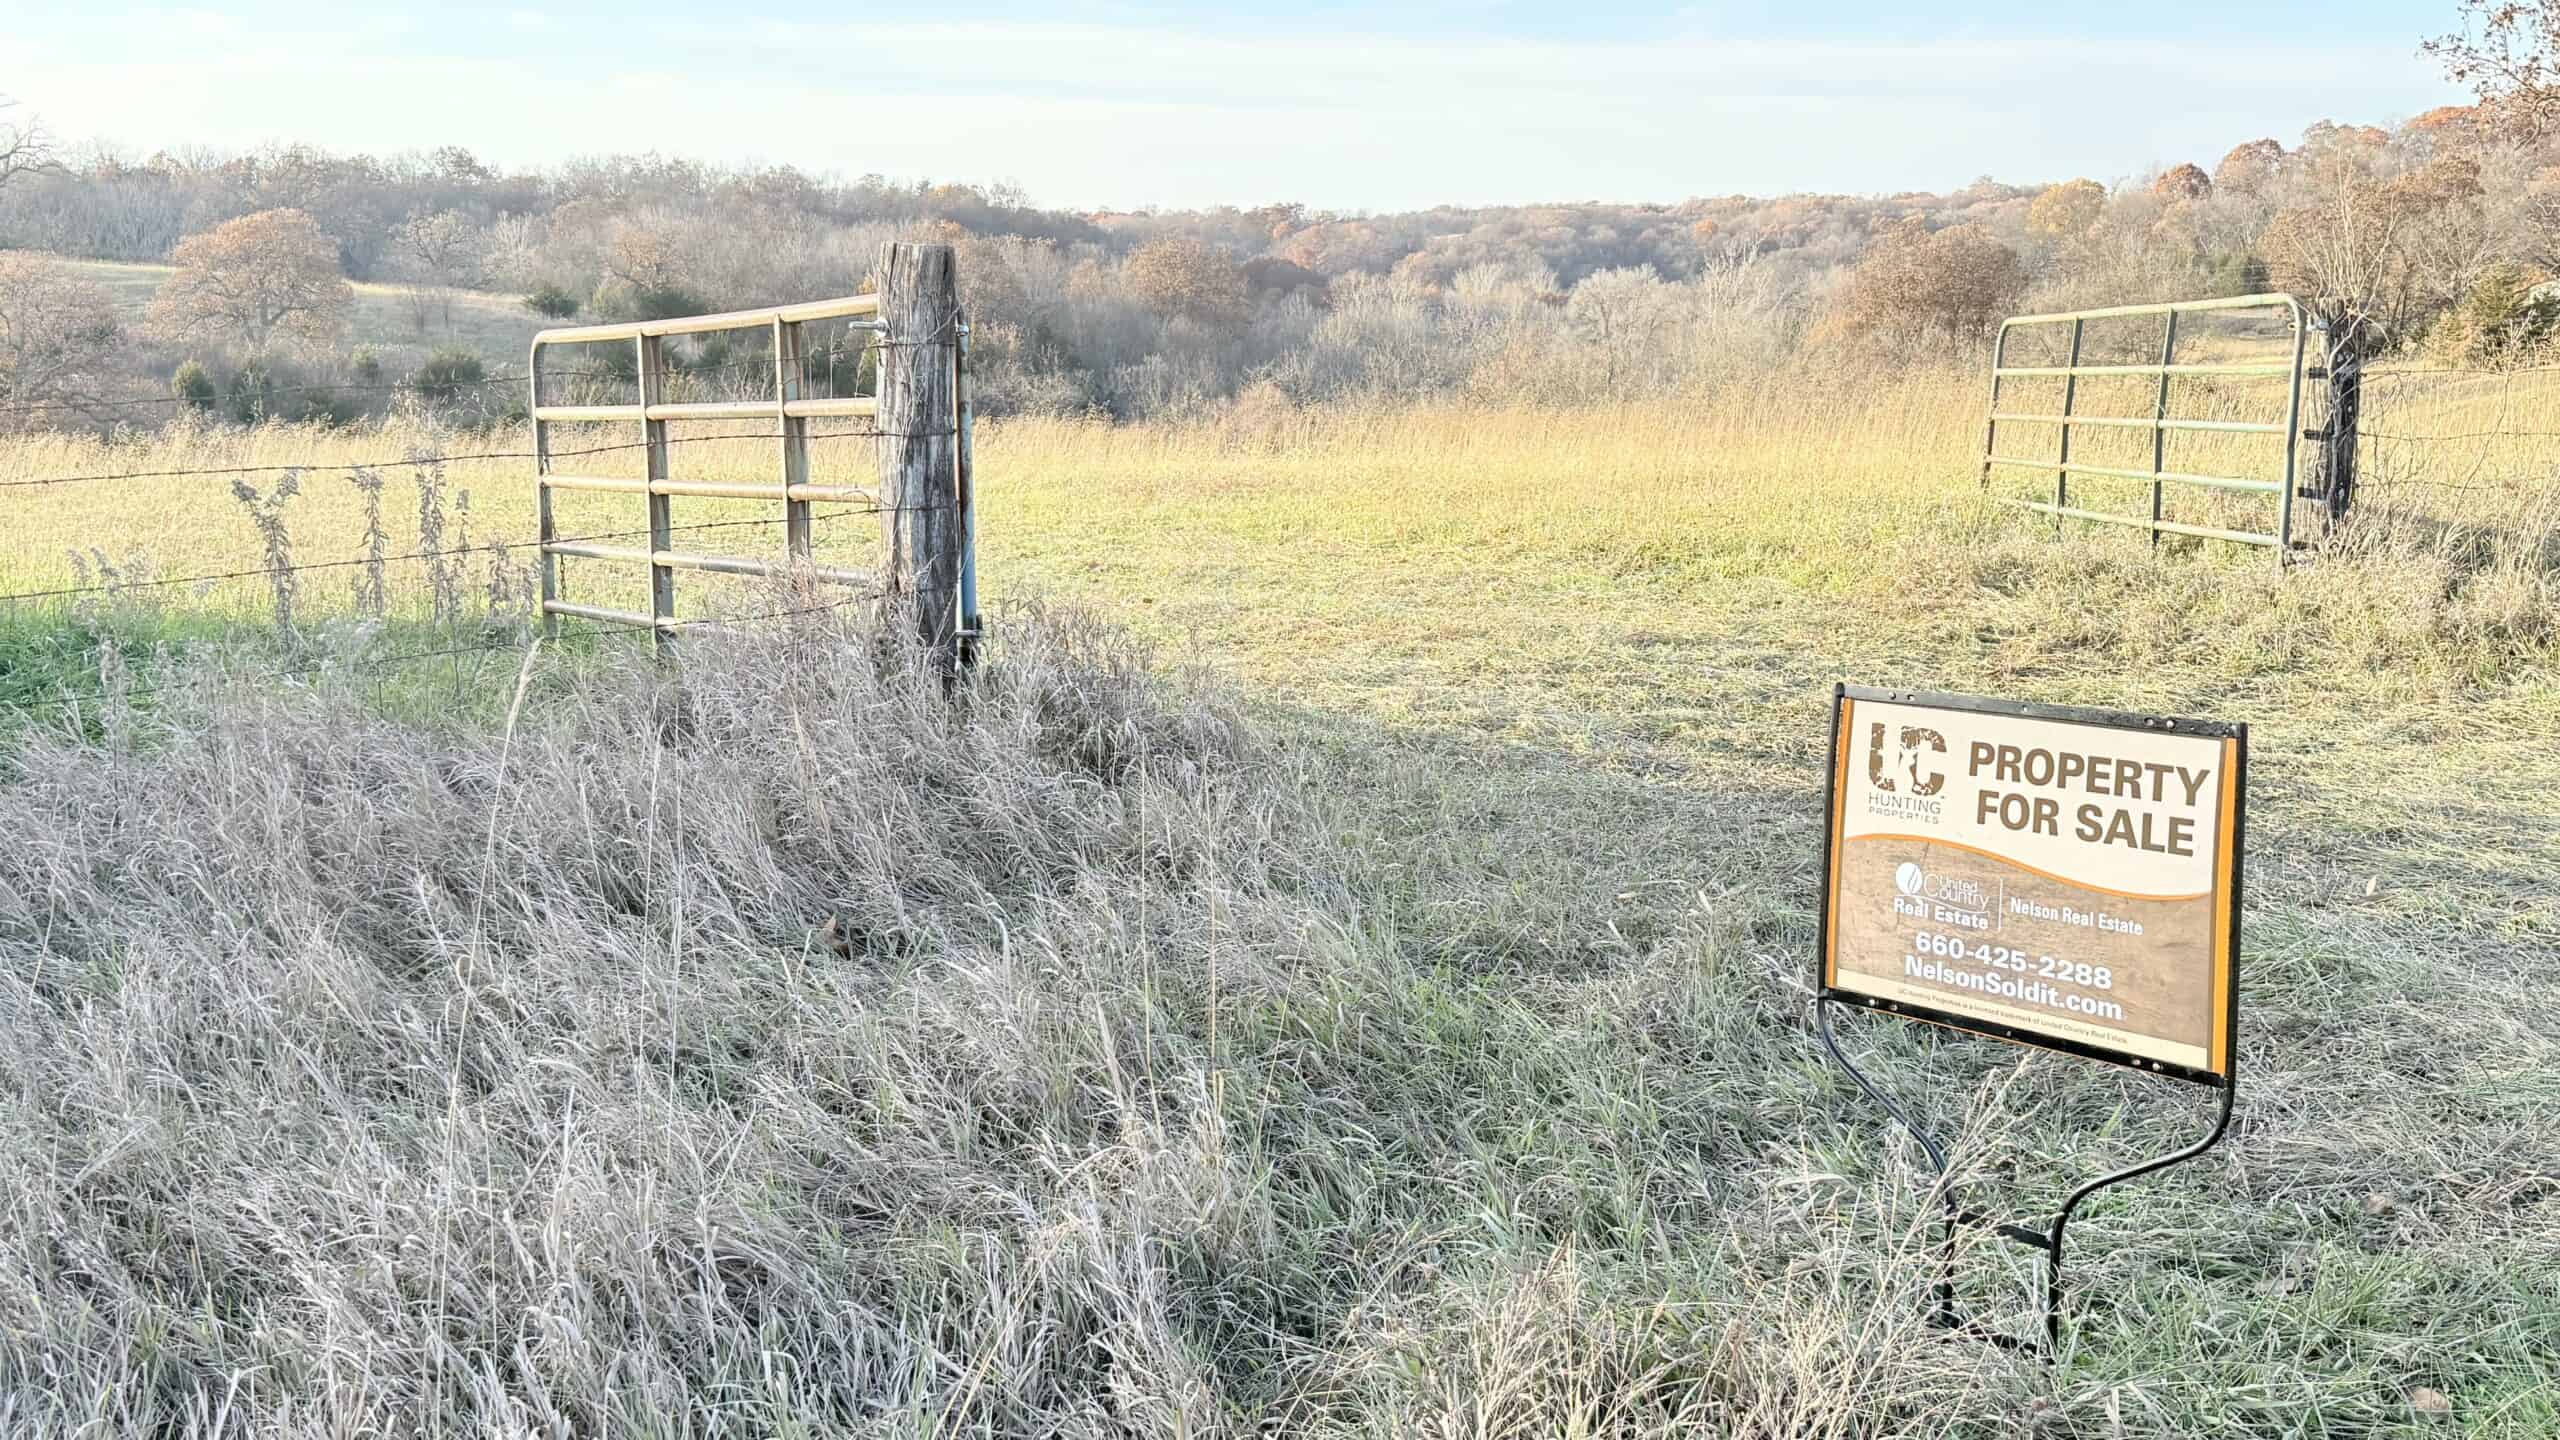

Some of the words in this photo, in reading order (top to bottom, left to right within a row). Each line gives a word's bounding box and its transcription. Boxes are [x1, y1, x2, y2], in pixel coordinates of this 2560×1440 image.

[1969, 741, 2211, 806] PROPERTY
[1868, 792, 1941, 815] HUNTING
[1868, 806, 1939, 825] PROPERTIES
[1977, 789, 2059, 836] FOR
[2075, 803, 2195, 857] SALE
[1923, 873, 1990, 912] Country
[1939, 874, 1978, 893] United
[1894, 897, 1929, 918] Real
[1935, 905, 1989, 929] Estate
[2010, 897, 2059, 920] Nelson
[2062, 906, 2094, 927] Real
[2098, 912, 2145, 935] Estate
[1915, 931, 2113, 989] 660-425-2288
[1904, 954, 2123, 1020] NelsonSoldit.com
